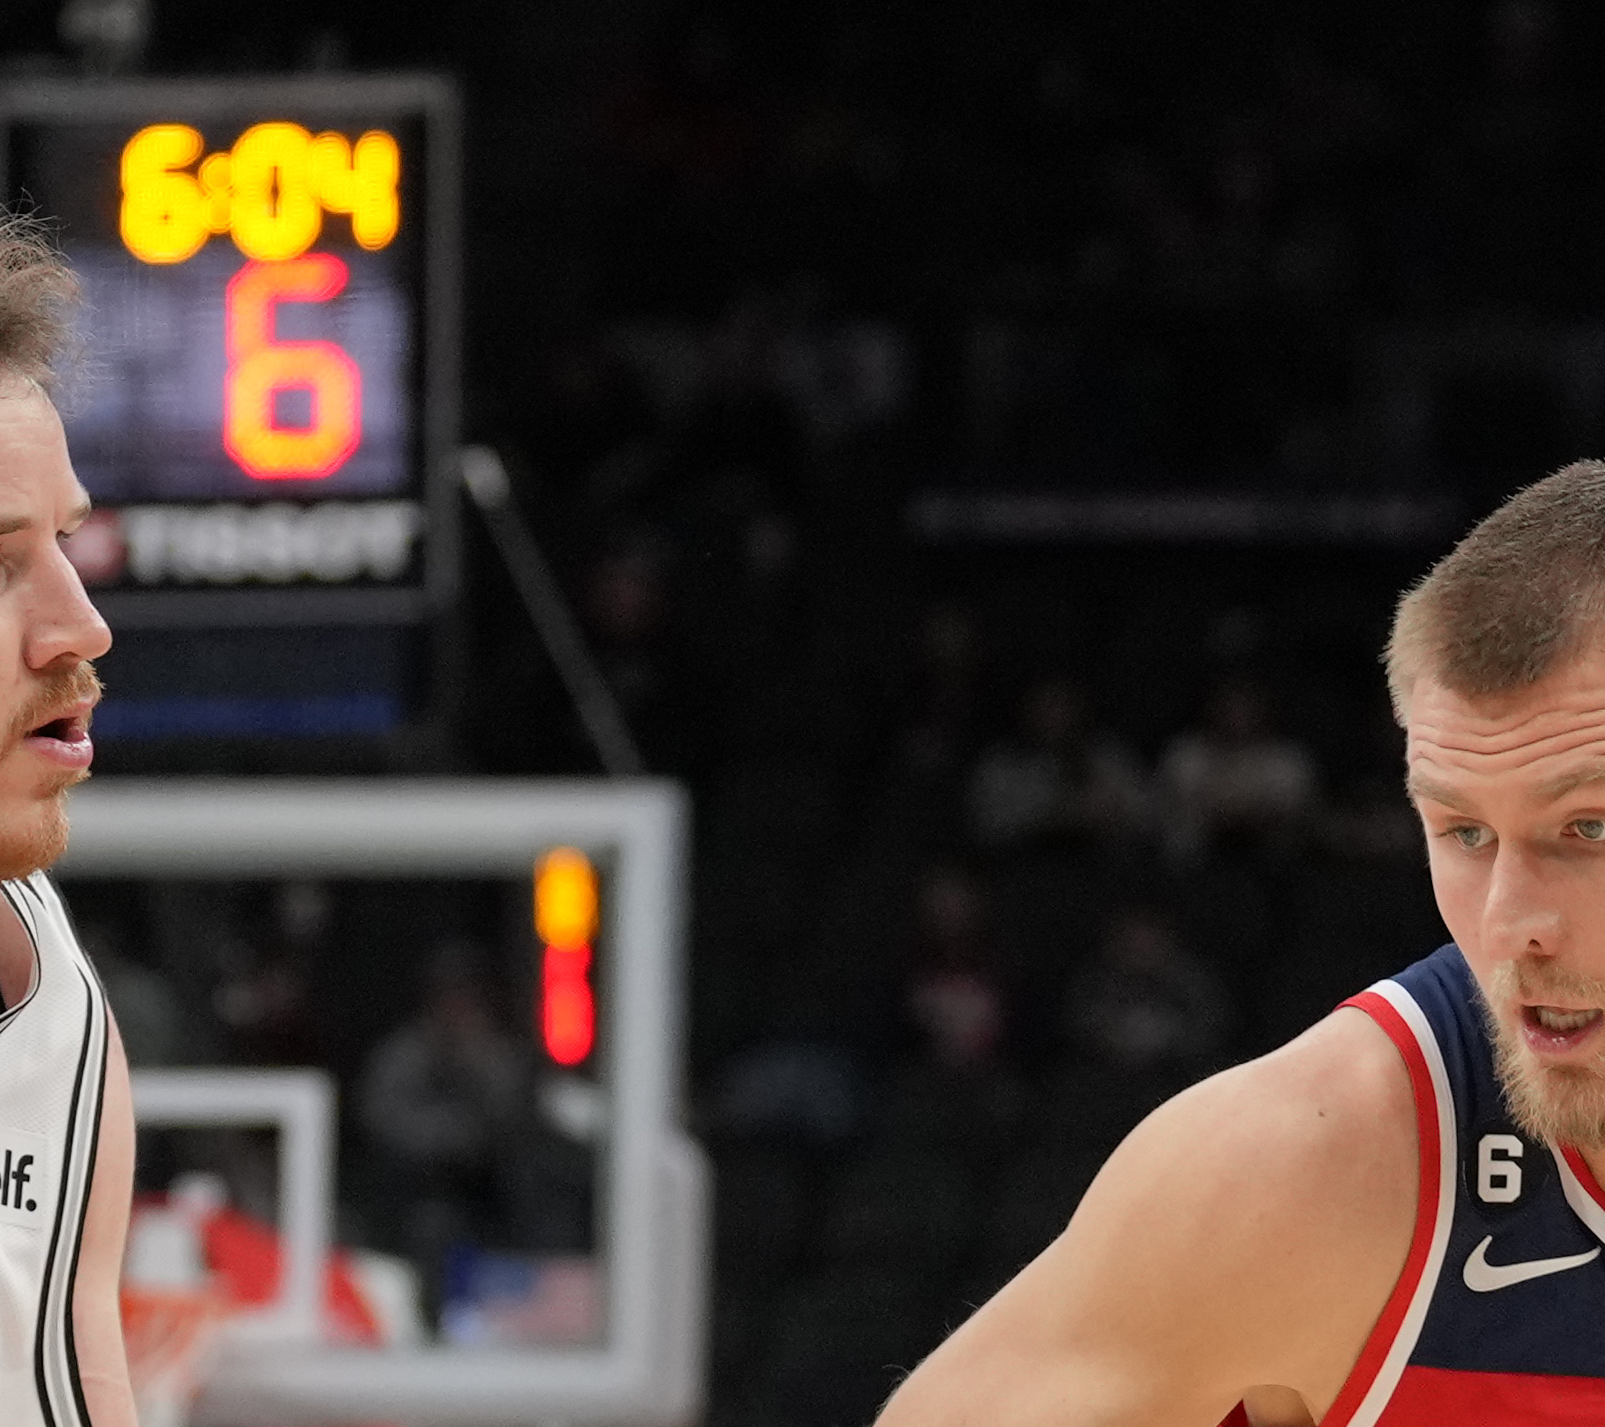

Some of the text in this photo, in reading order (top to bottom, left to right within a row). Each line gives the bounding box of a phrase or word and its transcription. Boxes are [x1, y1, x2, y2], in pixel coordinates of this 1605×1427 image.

[119, 121, 401, 265] 6:04
[223, 252, 363, 482] 6
[1475, 1133, 1524, 1203] 6
